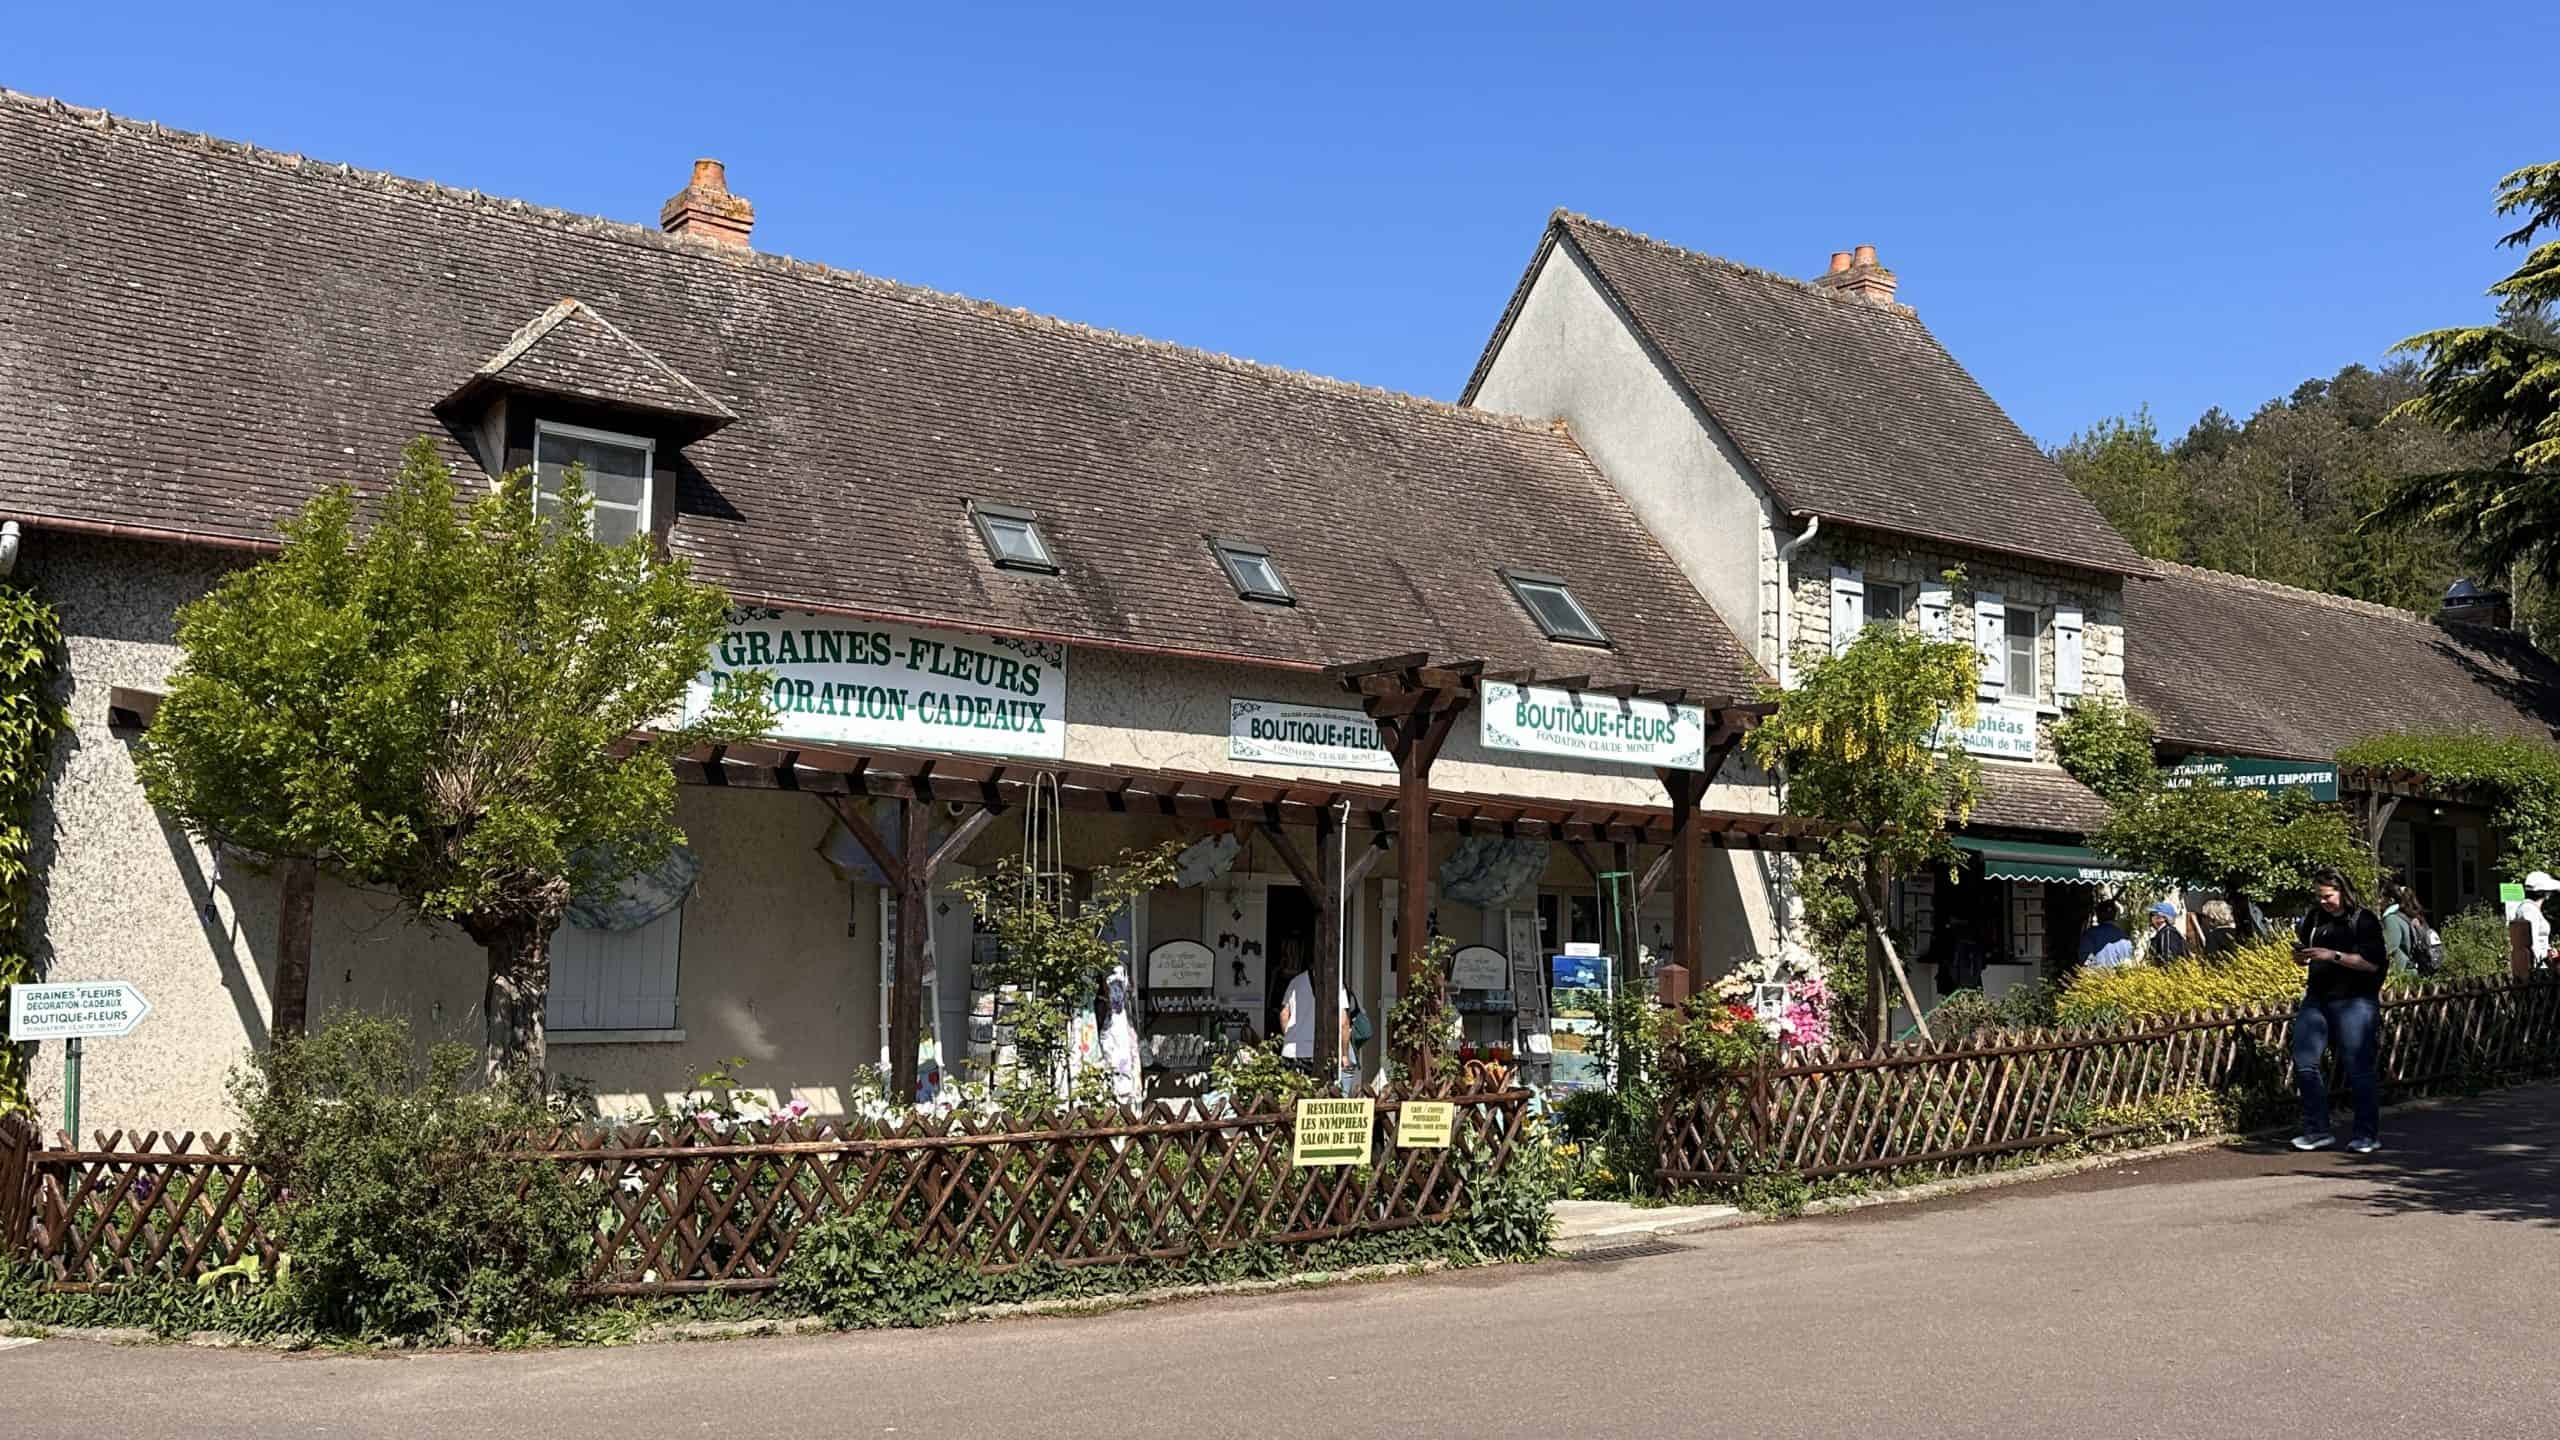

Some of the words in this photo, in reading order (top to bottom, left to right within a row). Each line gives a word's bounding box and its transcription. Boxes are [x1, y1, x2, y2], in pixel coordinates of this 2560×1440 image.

[720, 629, 1041, 697] GRAINES-FLEURS
[711, 670, 1047, 733] DORATION-CADEAUX
[1976, 715, 2024, 735] phéas
[1536, 730, 1586, 749] FONDATION
[1589, 741, 1622, 752] CLAUDE
[1626, 743, 1655, 753] MONET
[2234, 774, 2266, 787] VENTE
[2268, 774, 2277, 785] A
[2277, 771, 2332, 785] EMPORTER
[1306, 1102, 1365, 1115] RESTAURANT
[1301, 1117, 1317, 1130] LES
[1318, 1116, 1368, 1129] NYMPHEAS
[1301, 1132, 1330, 1145] SALON
[1332, 1132, 1345, 1144] DE
[1348, 1131, 1366, 1144] THE
